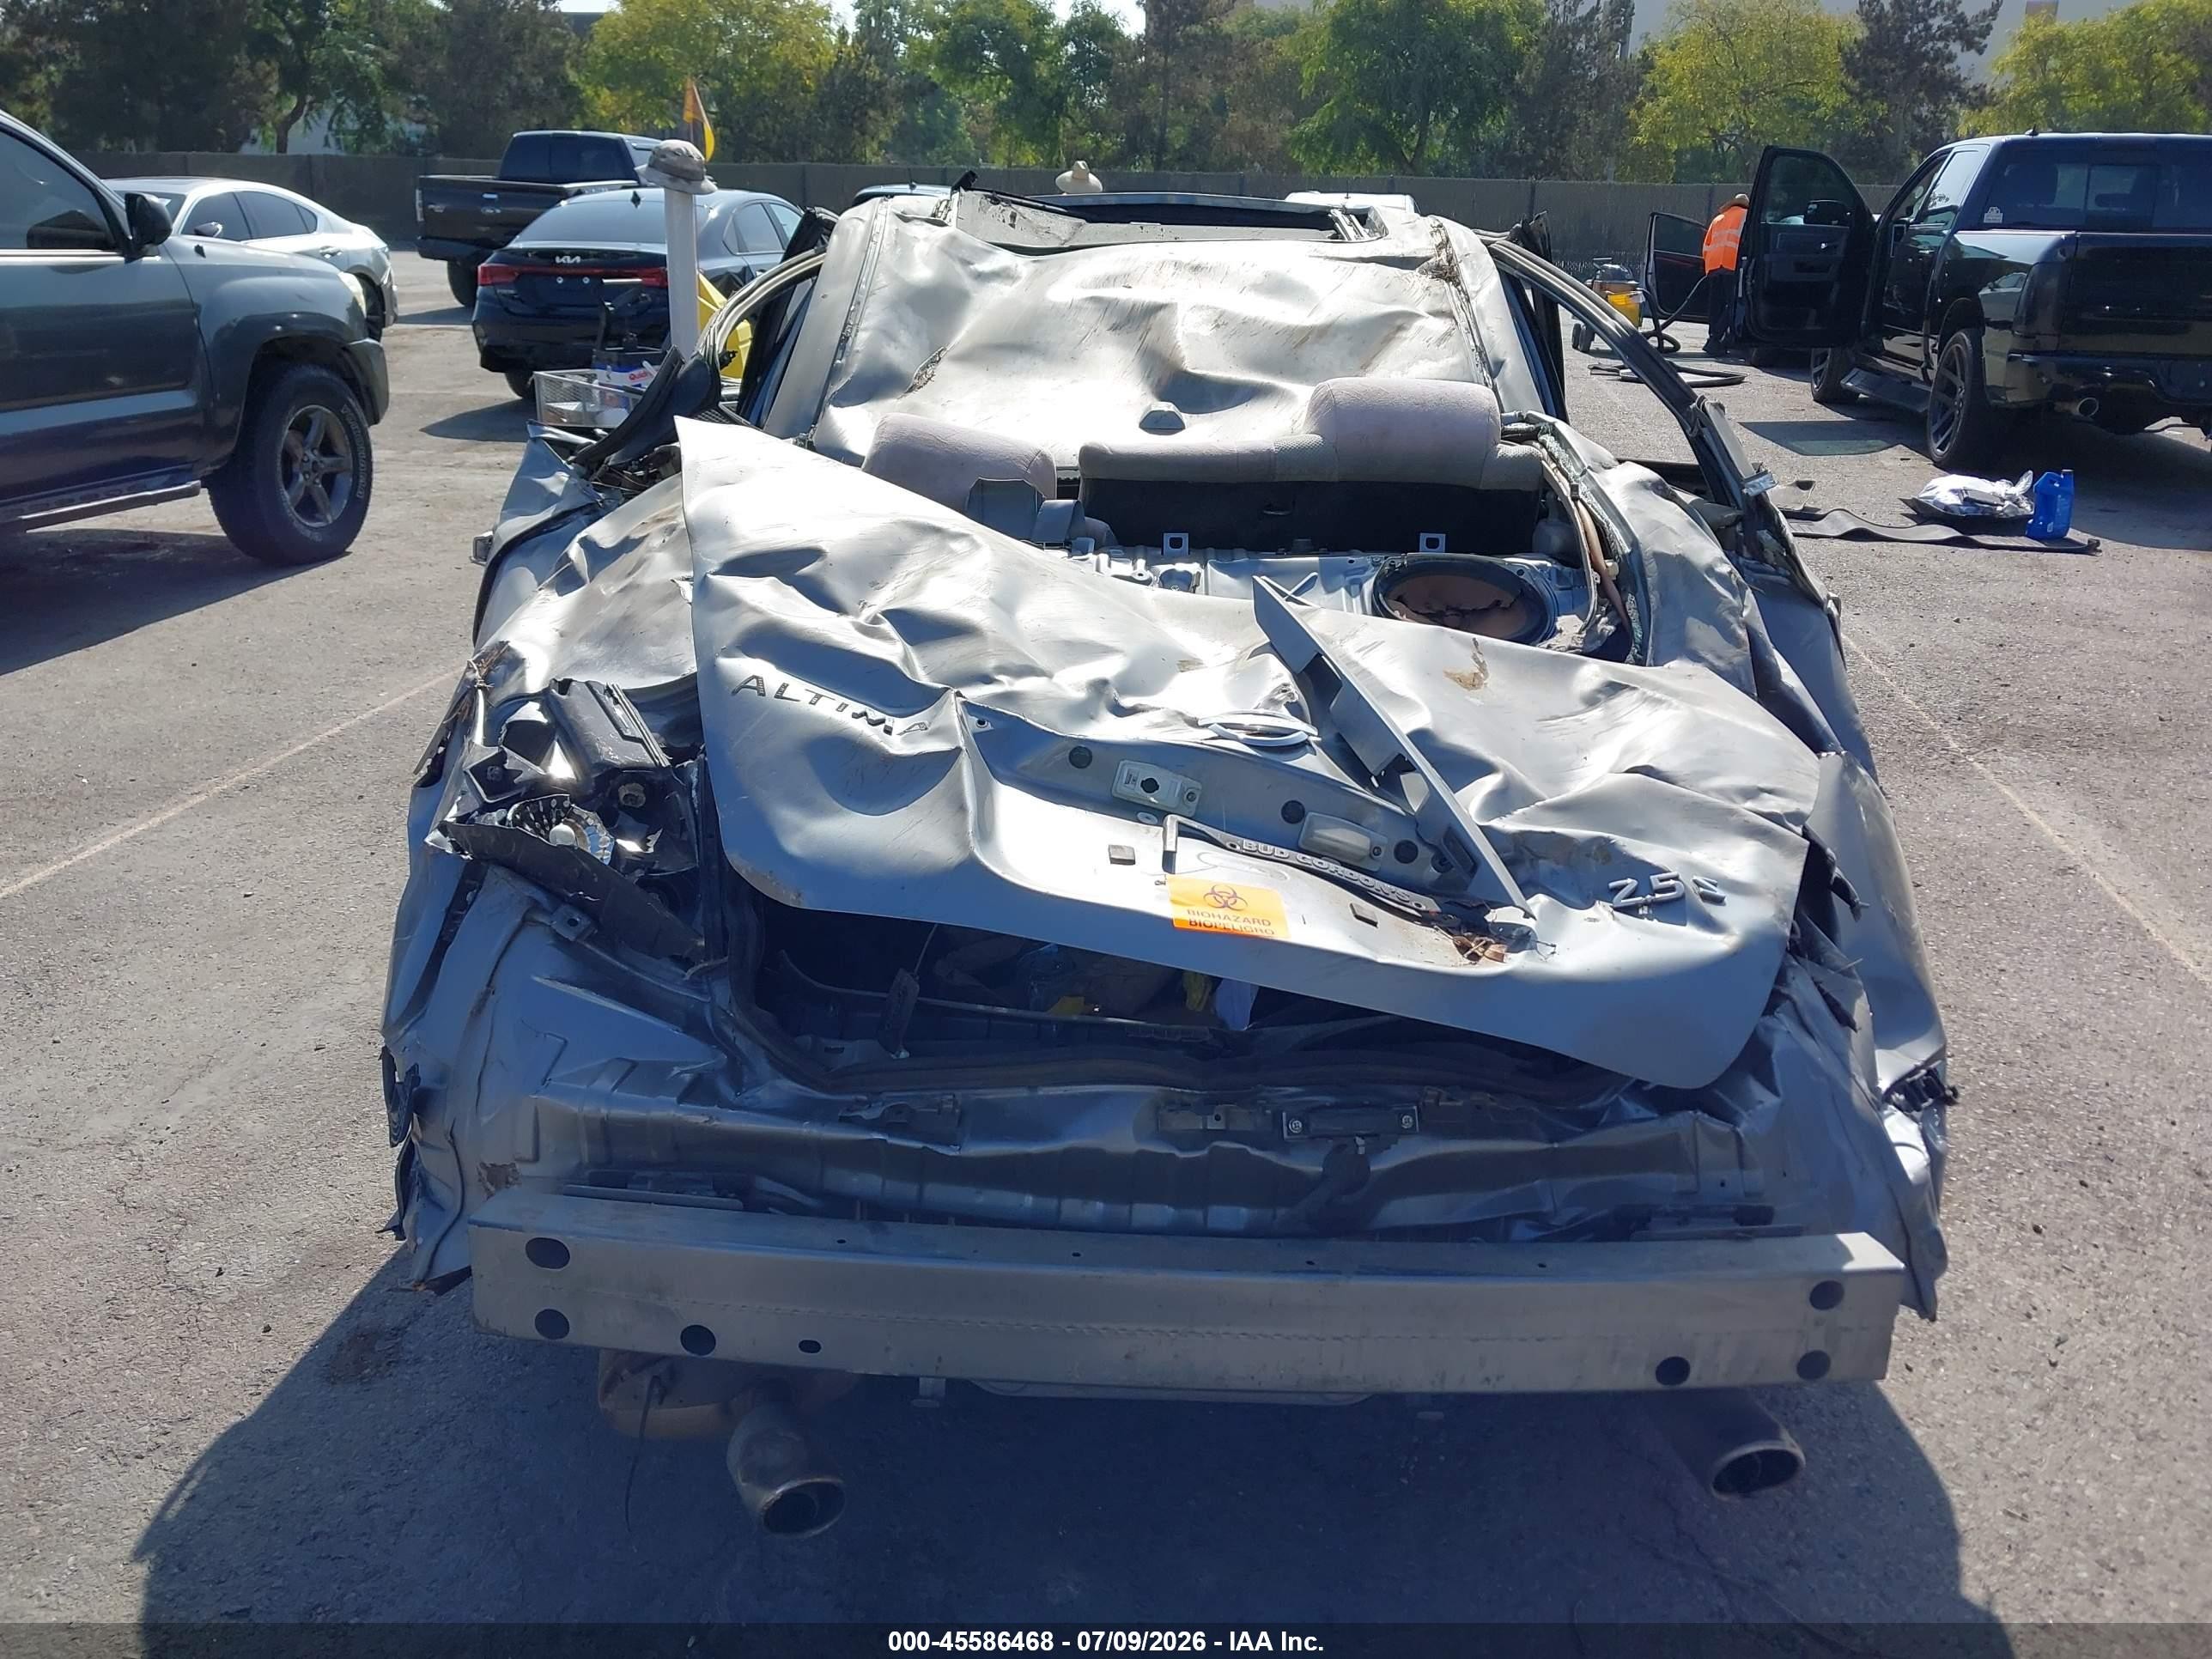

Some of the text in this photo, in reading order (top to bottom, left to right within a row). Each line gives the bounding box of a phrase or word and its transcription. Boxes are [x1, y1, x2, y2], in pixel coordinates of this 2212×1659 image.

[731, 674, 929, 736] ALTIMA
[1242, 839, 1289, 859] BUD
[1187, 908, 1272, 927] BIOHAZARD
[1188, 918, 1275, 935] BIOPELIGRO
